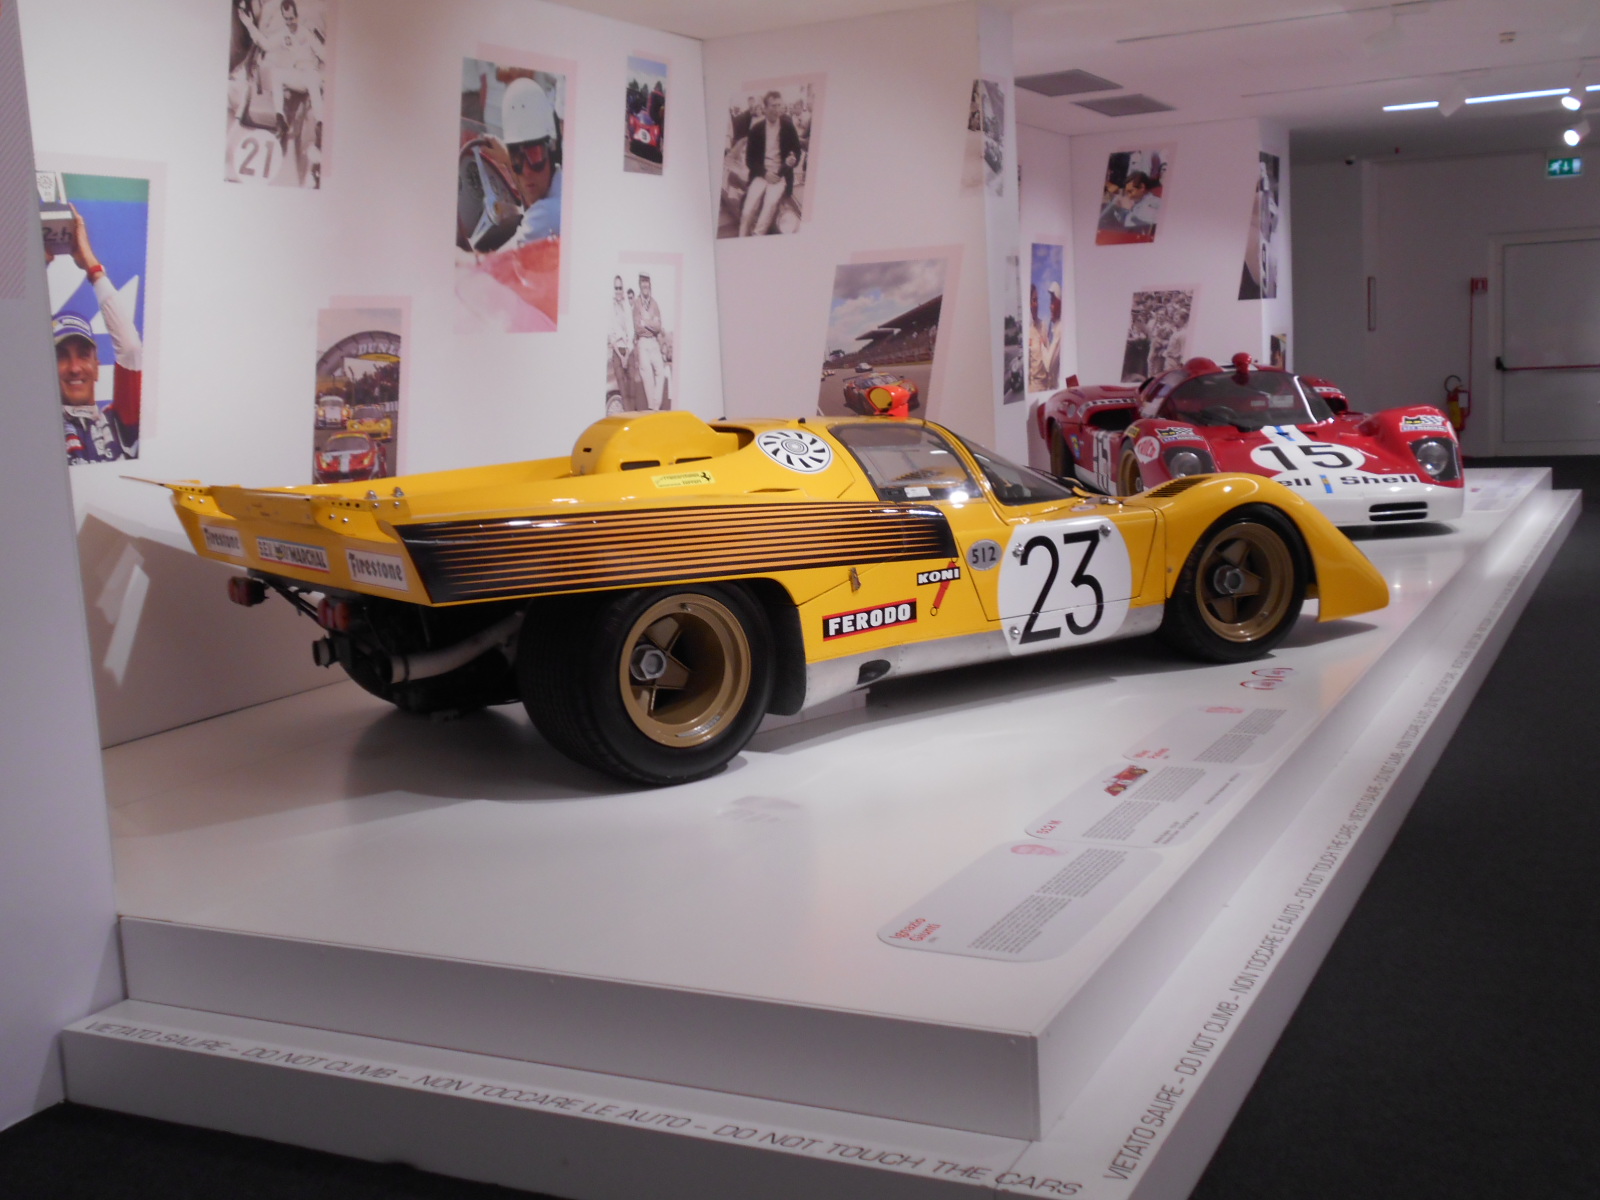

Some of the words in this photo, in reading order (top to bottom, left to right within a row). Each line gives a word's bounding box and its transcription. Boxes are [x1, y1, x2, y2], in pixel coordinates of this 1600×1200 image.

[238, 136, 275, 179] 21
[358, 343, 401, 355] DUNL
[1259, 444, 1354, 471] 15
[1278, 477, 1312, 487] ell
[1340, 474, 1418, 486] Shell
[349, 552, 403, 582] Firestone
[971, 546, 997, 564] 512
[917, 568, 960, 585] KONI
[1019, 529, 1105, 645] 23
[828, 603, 911, 636] FERODO
[1228, 971, 1260, 994] NON
[1203, 1001, 1240, 1033] CLIMB
[1186, 1032, 1218, 1057] NOT
[1174, 1057, 1203, 1076] DO
[85, 1021, 162, 1040] VIETATO
[157, 1033, 231, 1051] SALIRE
[241, 1048, 279, 1059] DO
[275, 1052, 329, 1066] NOT
[323, 1060, 398, 1079] CLIMB
[412, 1075, 473, 1091] NON
[471, 1083, 584, 1110] TOCCARE
[581, 1102, 619, 1116] LE
[616, 1109, 692, 1129] AUTO
[712, 1124, 758, 1140] DO
[758, 1132, 824, 1150] NOT
[826, 1142, 926, 1169] TOUCH
[932, 1159, 992, 1180] THE
[994, 1172, 1083, 1196] CARS
[1140, 1084, 1185, 1128] SALIRE
[1102, 1126, 1156, 1180] VIETATO
